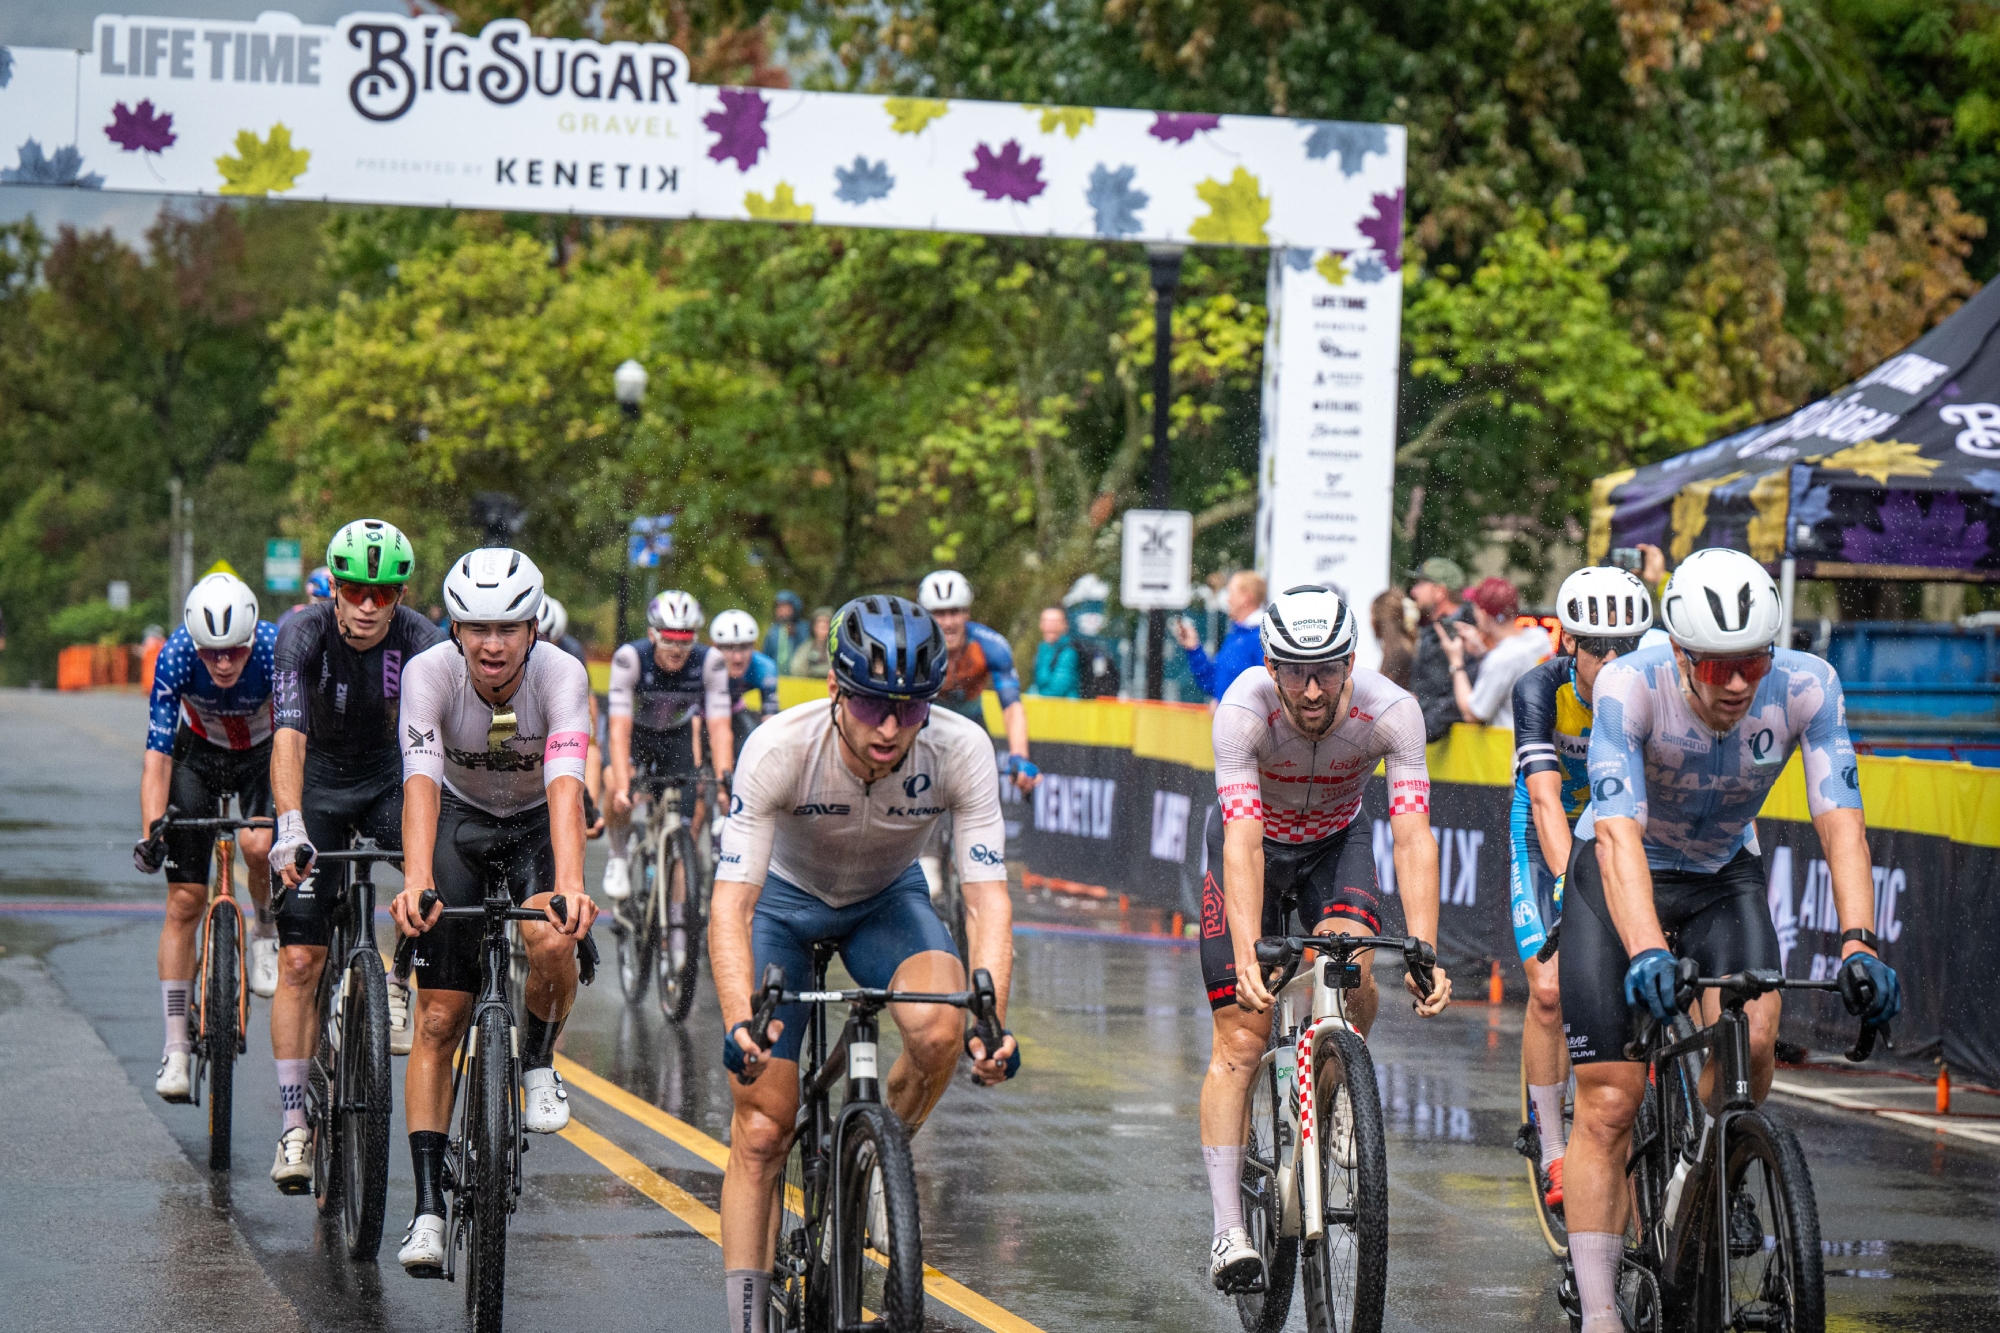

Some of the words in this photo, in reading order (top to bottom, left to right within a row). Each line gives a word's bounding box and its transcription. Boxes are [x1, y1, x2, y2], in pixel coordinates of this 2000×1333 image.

[101, 25, 195, 78] LIFE
[203, 31, 321, 84] TIME
[478, 31, 679, 105] SUGAR
[557, 112, 680, 138] GRAVEL
[496, 157, 679, 192] KENETIK
[1292, 618, 1328, 626] GOODLIFE
[1292, 624, 1329, 632] NUTRITION
[335, 683, 348, 714] ZWIFT
[1661, 731, 1709, 752] SHIMANO
[1736, 1080, 1748, 1094] 3T
